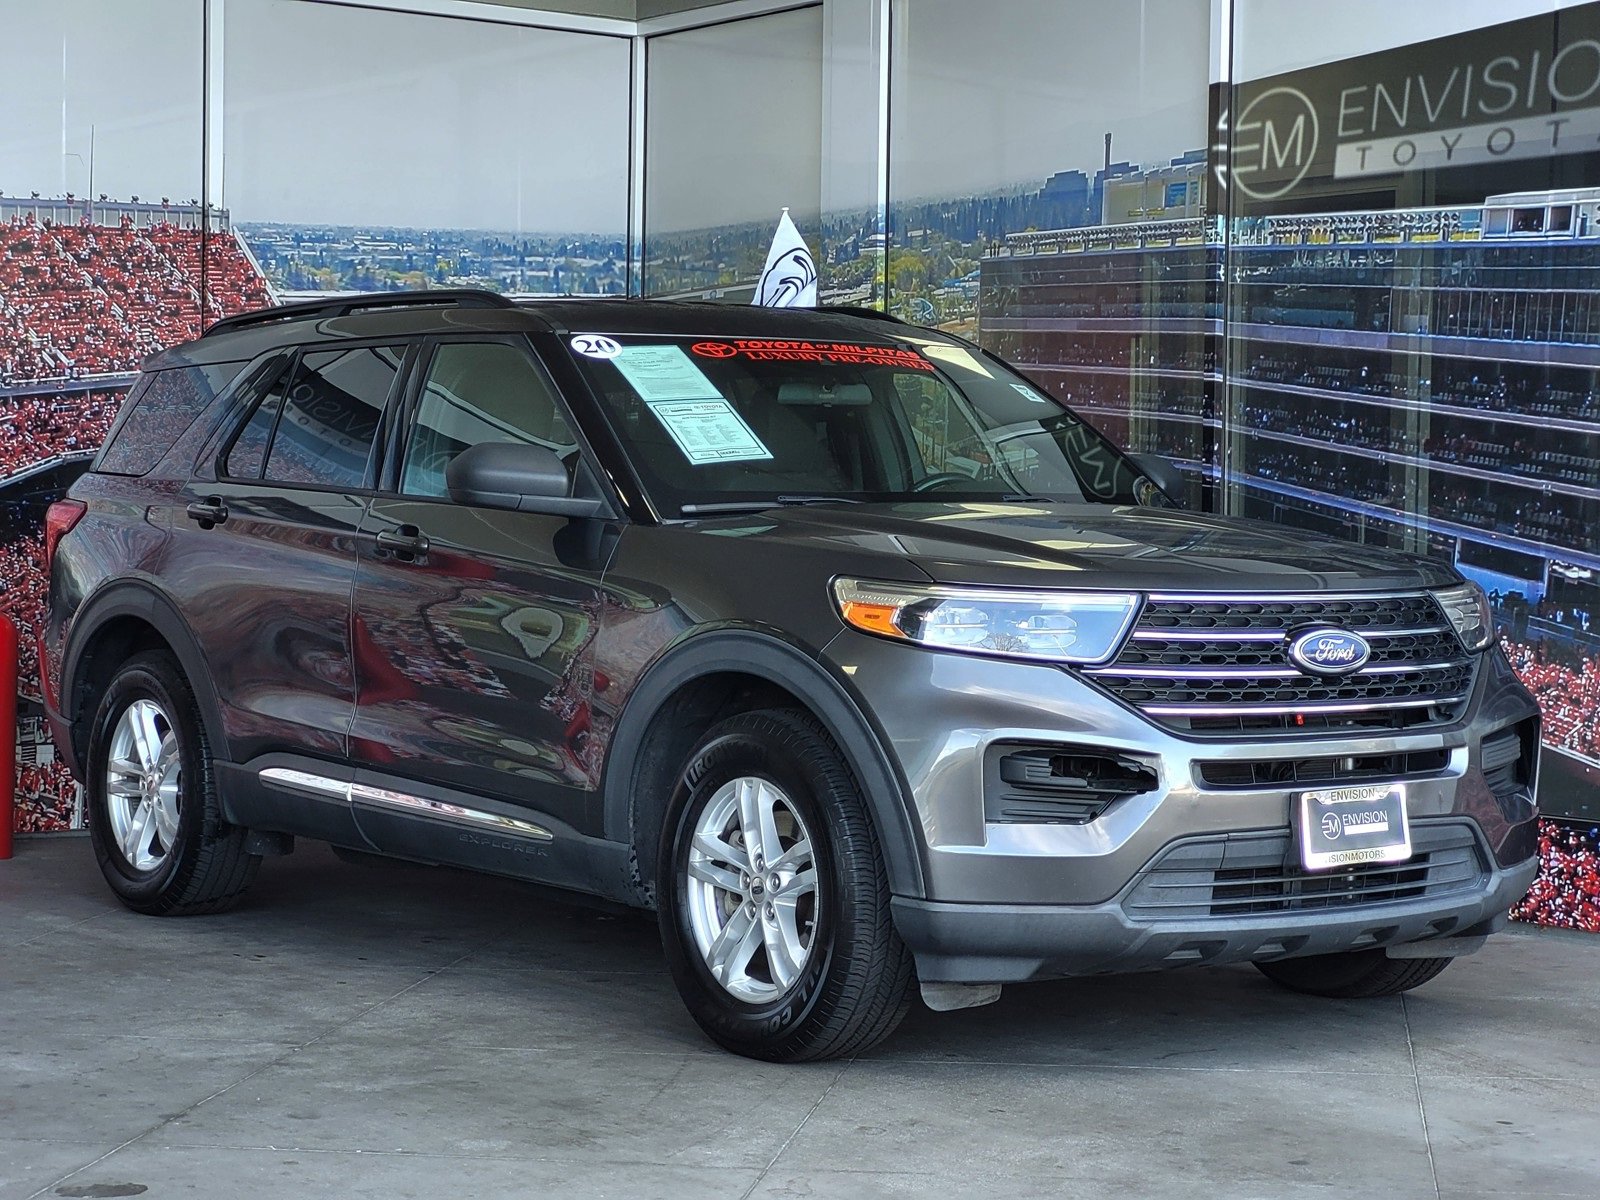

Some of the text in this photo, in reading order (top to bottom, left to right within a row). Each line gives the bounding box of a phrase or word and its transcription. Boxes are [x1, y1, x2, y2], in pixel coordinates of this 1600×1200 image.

[1356, 118, 1600, 171] TOYOT
[575, 339, 616, 354] 20
[734, 340, 815, 350] TOYOTA
[832, 343, 921, 360] MILPITAS
[746, 351, 936, 372] LUXURY PRE-OWNED
[1315, 638, 1355, 661] Ford
[1330, 788, 1376, 802] ENVISION
[1342, 810, 1388, 826] ENVISION
[459, 832, 549, 858] EXPLORER
